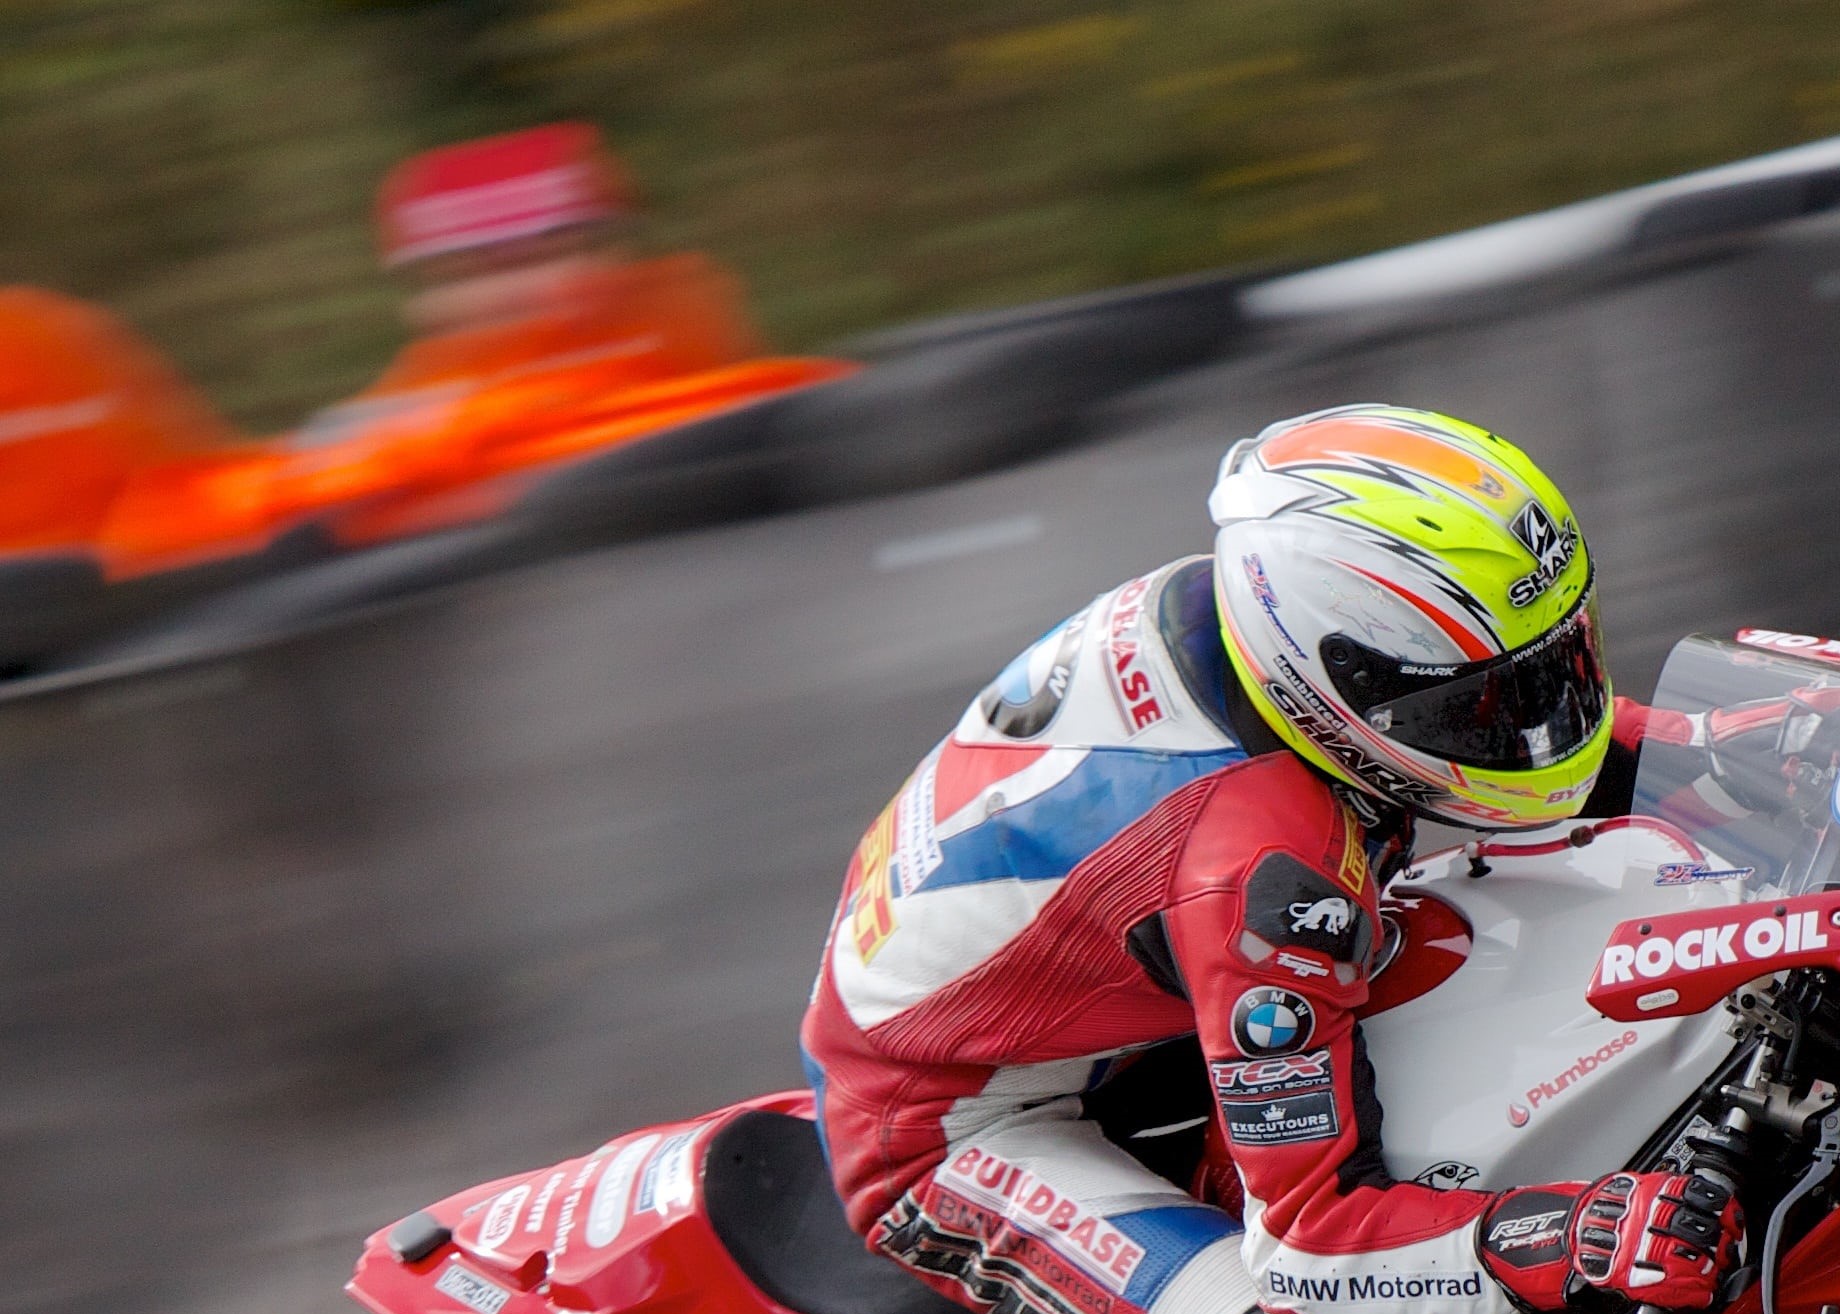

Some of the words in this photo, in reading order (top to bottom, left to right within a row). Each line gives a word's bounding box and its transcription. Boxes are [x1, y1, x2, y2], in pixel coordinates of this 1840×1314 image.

[1508, 516, 1582, 608] SHARK
[1742, 629, 1818, 646] OIL
[1274, 657, 1346, 729] doublered
[1400, 664, 1458, 678] SHARK
[1267, 680, 1450, 806] SHARK
[1600, 925, 1739, 987] ROCK
[1744, 911, 1829, 953] OIL
[1211, 1049, 1331, 1088] TCX
[1527, 1028, 1641, 1109] Plumbase
[1230, 1113, 1329, 1133] EXECUTOURS
[951, 1147, 1138, 1280] BUILDBASE
[1488, 1210, 1567, 1241] RST
[1269, 1270, 1341, 1302] BMW
[1349, 1271, 1482, 1300] Motorrad
